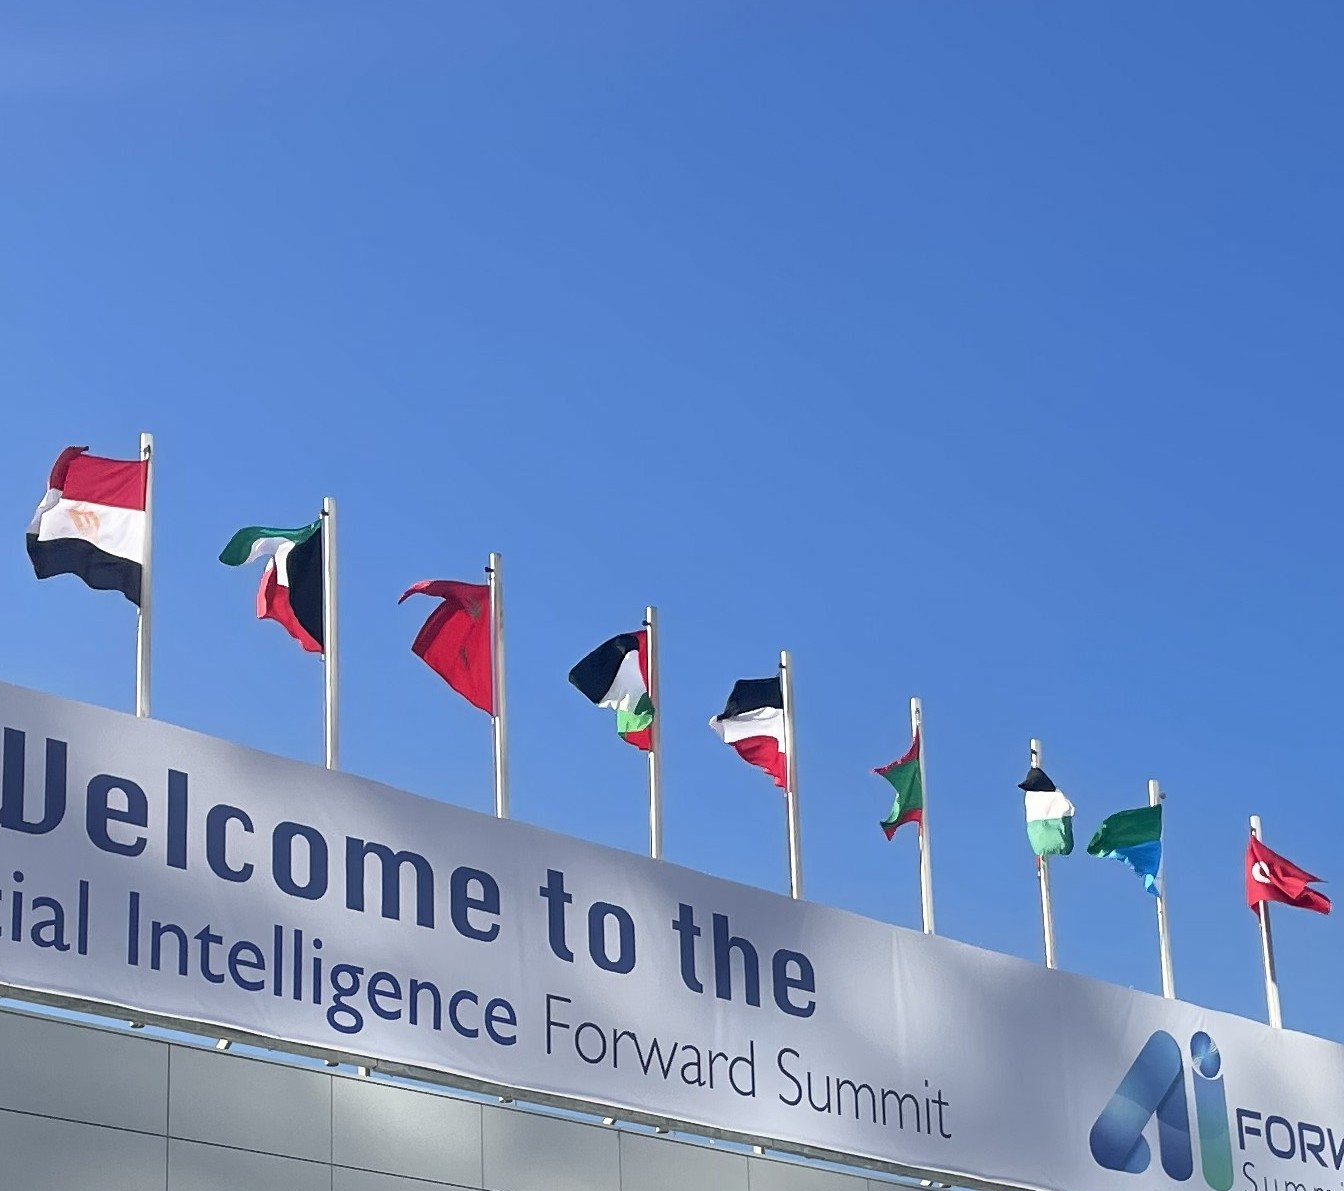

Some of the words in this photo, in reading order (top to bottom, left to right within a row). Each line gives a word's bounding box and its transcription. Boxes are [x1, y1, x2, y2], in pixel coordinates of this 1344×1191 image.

[128, 891, 518, 1046] Intelligence
[545, 993, 756, 1097] Forward
[778, 1047, 952, 1139] Summit
[539, 868, 636, 974] to
[672, 902, 816, 1018] the
